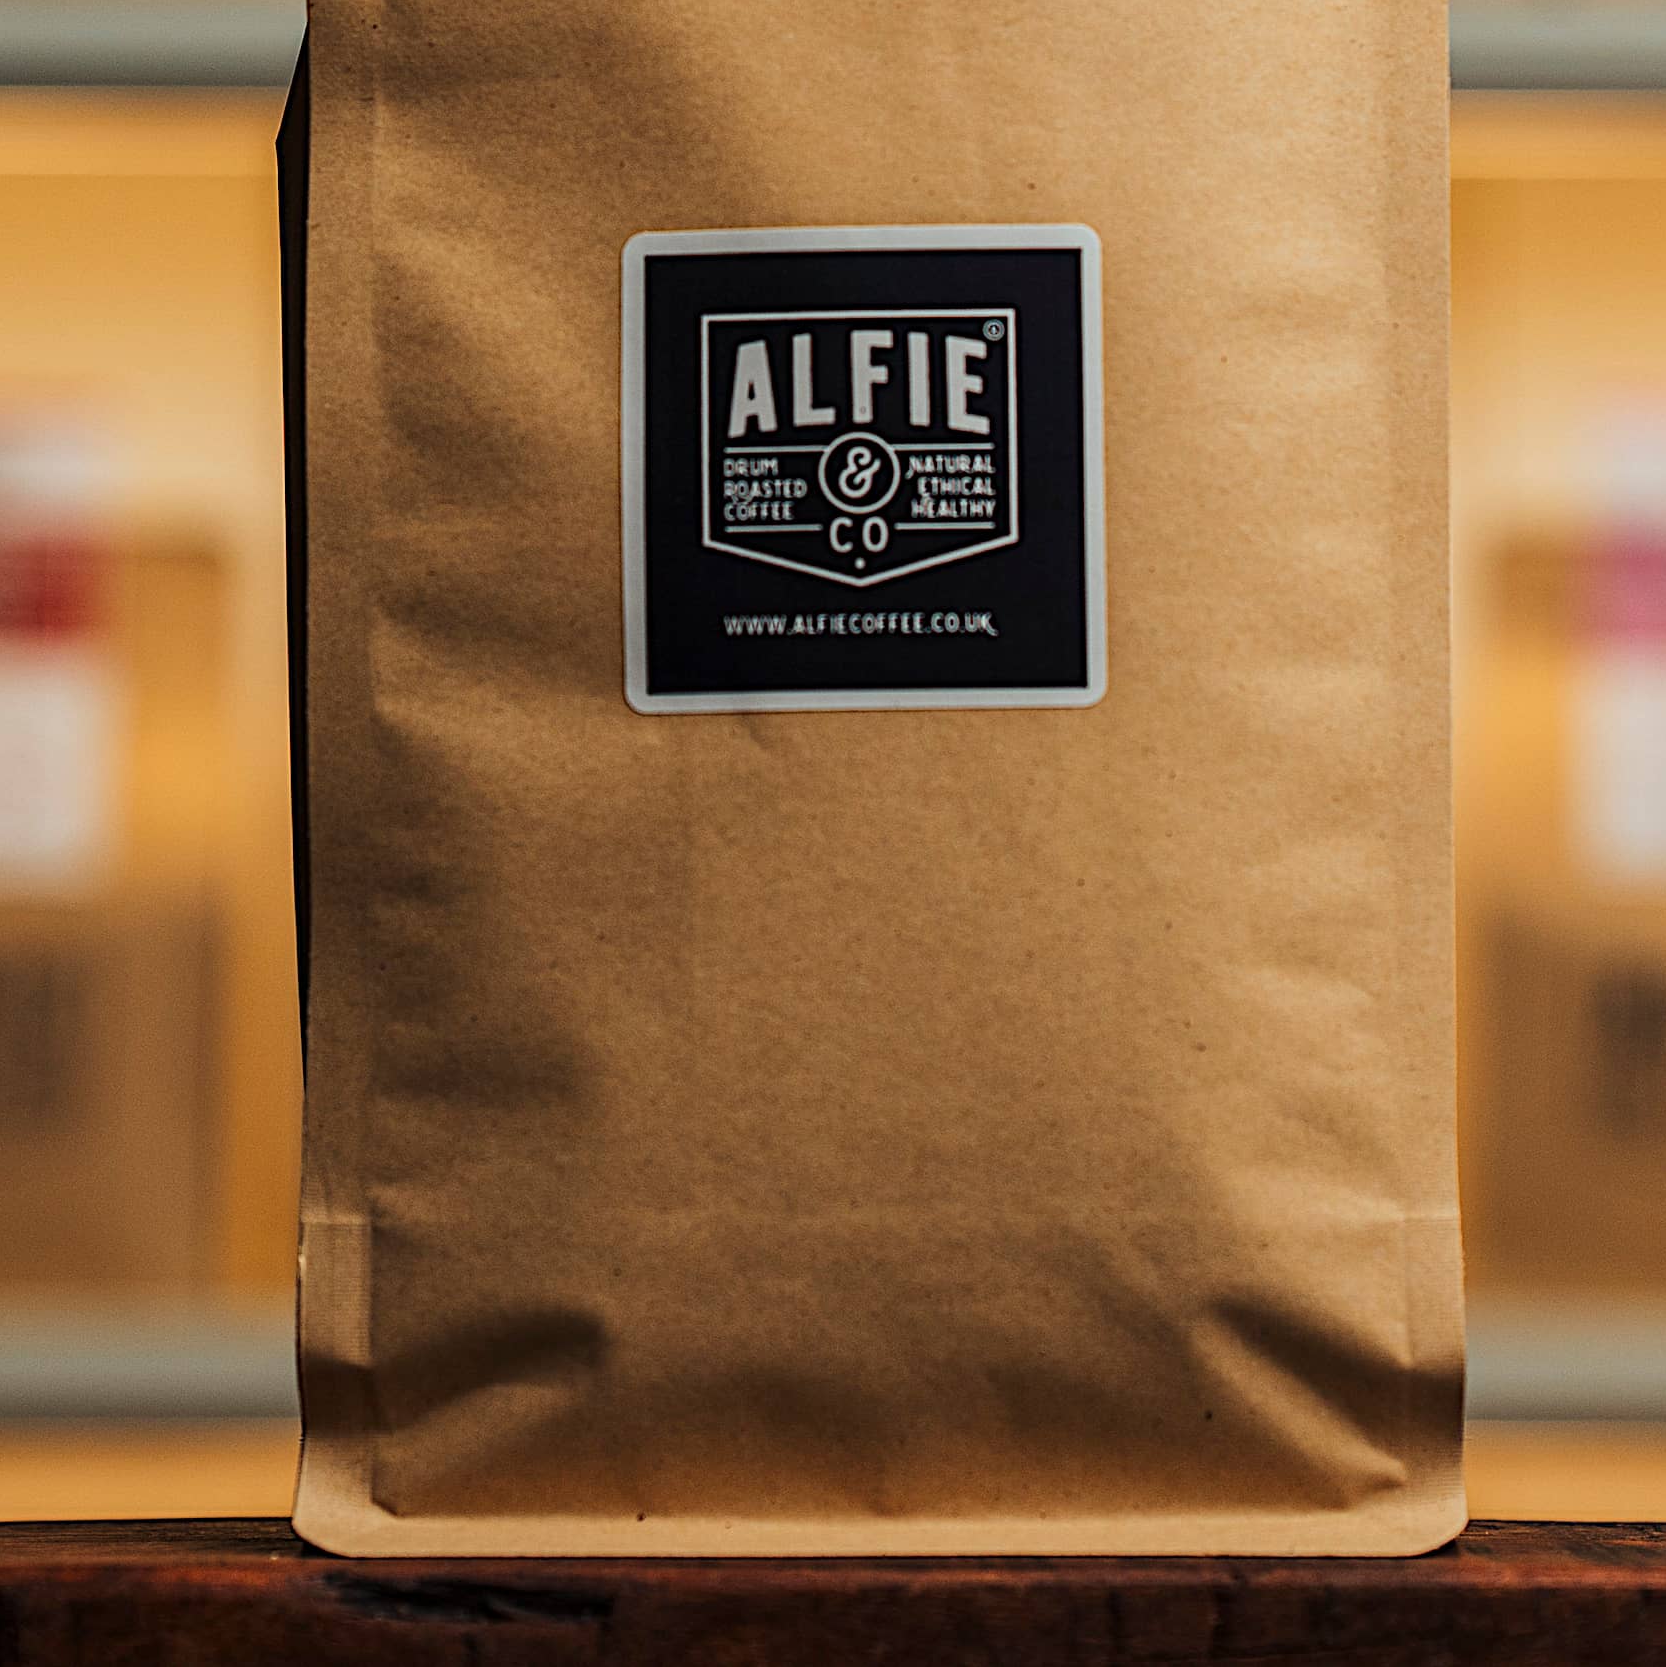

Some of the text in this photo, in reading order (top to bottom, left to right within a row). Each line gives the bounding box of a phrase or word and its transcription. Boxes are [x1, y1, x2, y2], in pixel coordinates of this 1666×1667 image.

[727, 329, 991, 439] ALFIE
[723, 457, 779, 477] DRUM
[907, 454, 996, 476] NATURAL
[723, 478, 807, 501] ROASTED
[917, 477, 996, 497] ETHICAL
[724, 501, 794, 521] COFFEE
[911, 498, 997, 518] HEALTHY
[829, 518, 889, 552] CO
[724, 611, 999, 636] WWW.ALFIECOFFEE.CO.UK
